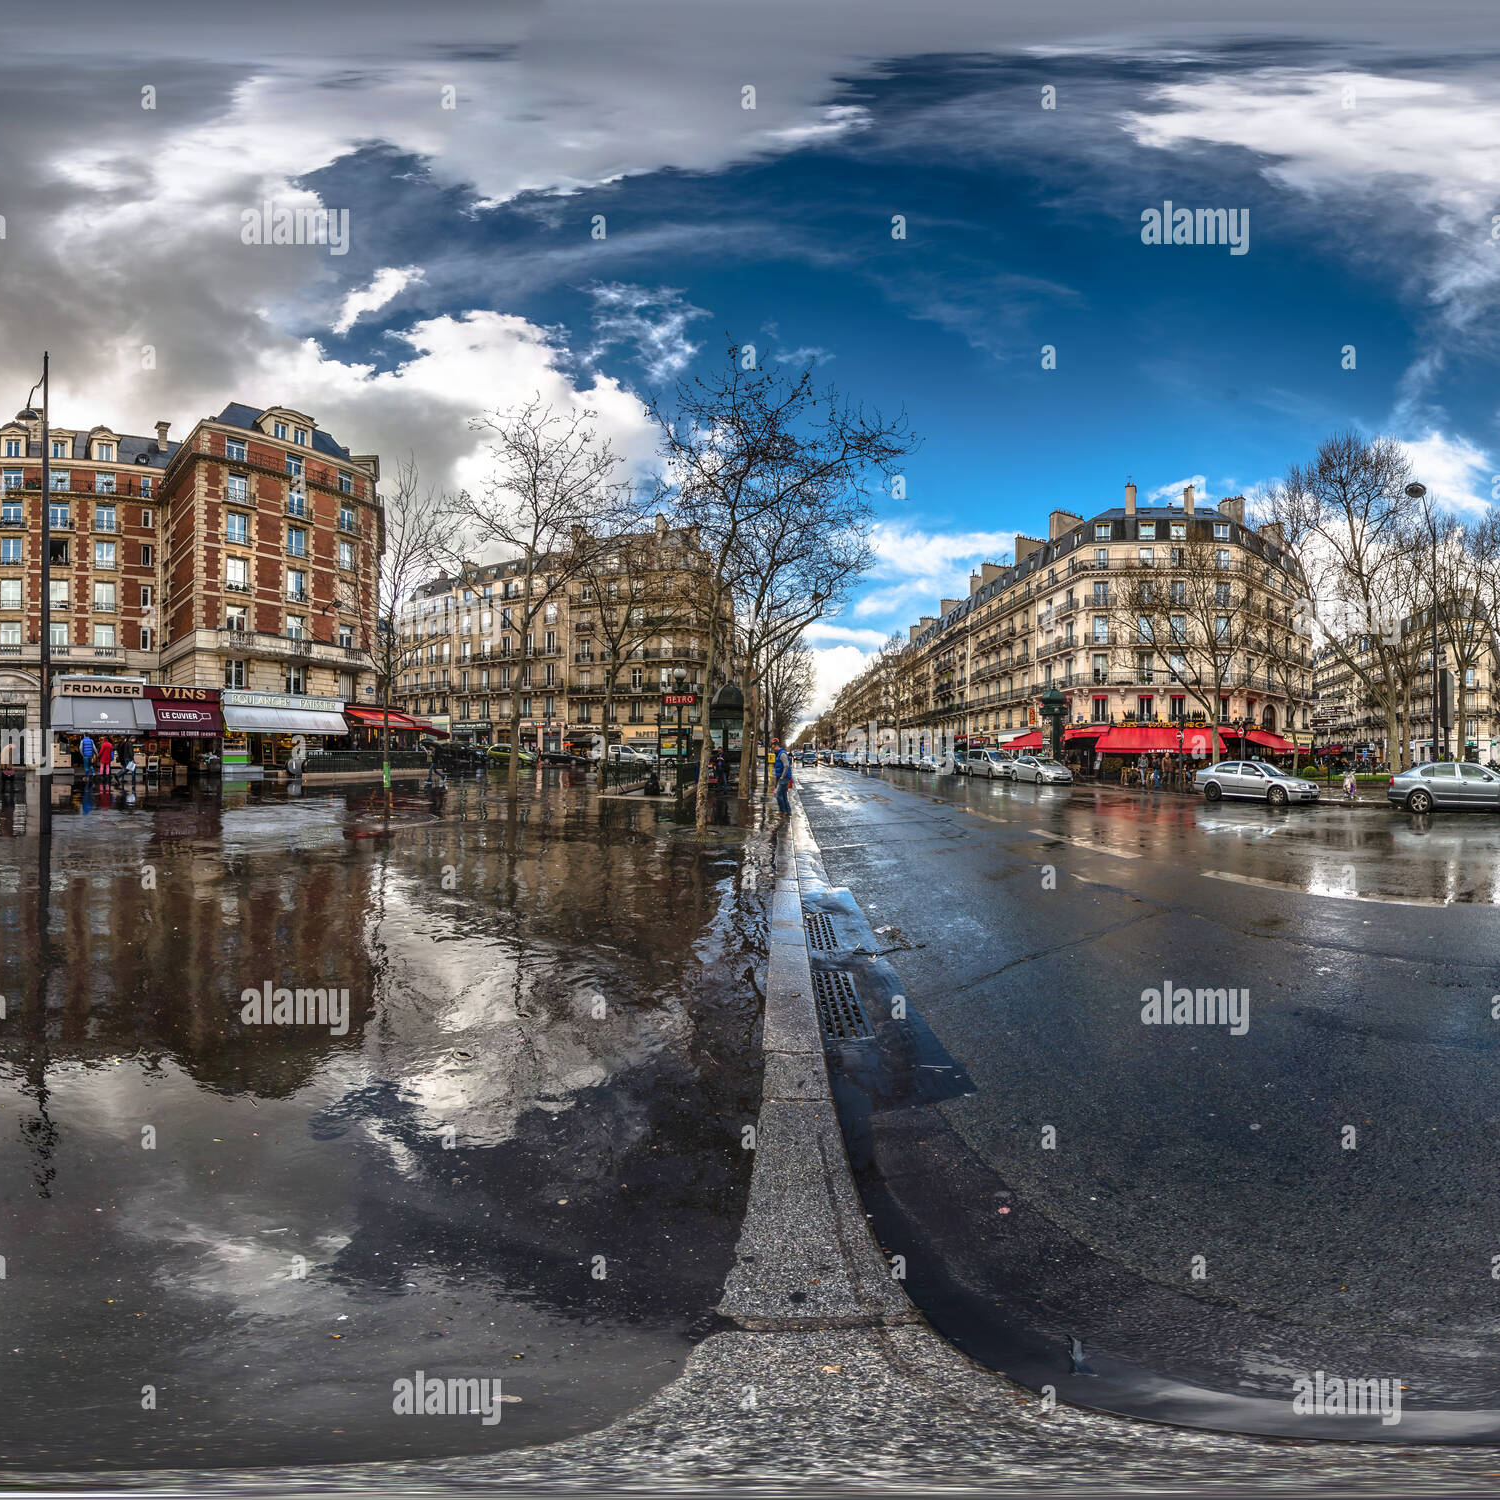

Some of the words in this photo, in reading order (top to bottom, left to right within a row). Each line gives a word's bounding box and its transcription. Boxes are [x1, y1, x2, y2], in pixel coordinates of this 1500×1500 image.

[63, 684, 140, 695] FROMAGER
[160, 687, 206, 700] VINS
[231, 694, 290, 707] BOULANGER
[161, 711, 171, 719] LE
[172, 712, 198, 720] CUVIER
